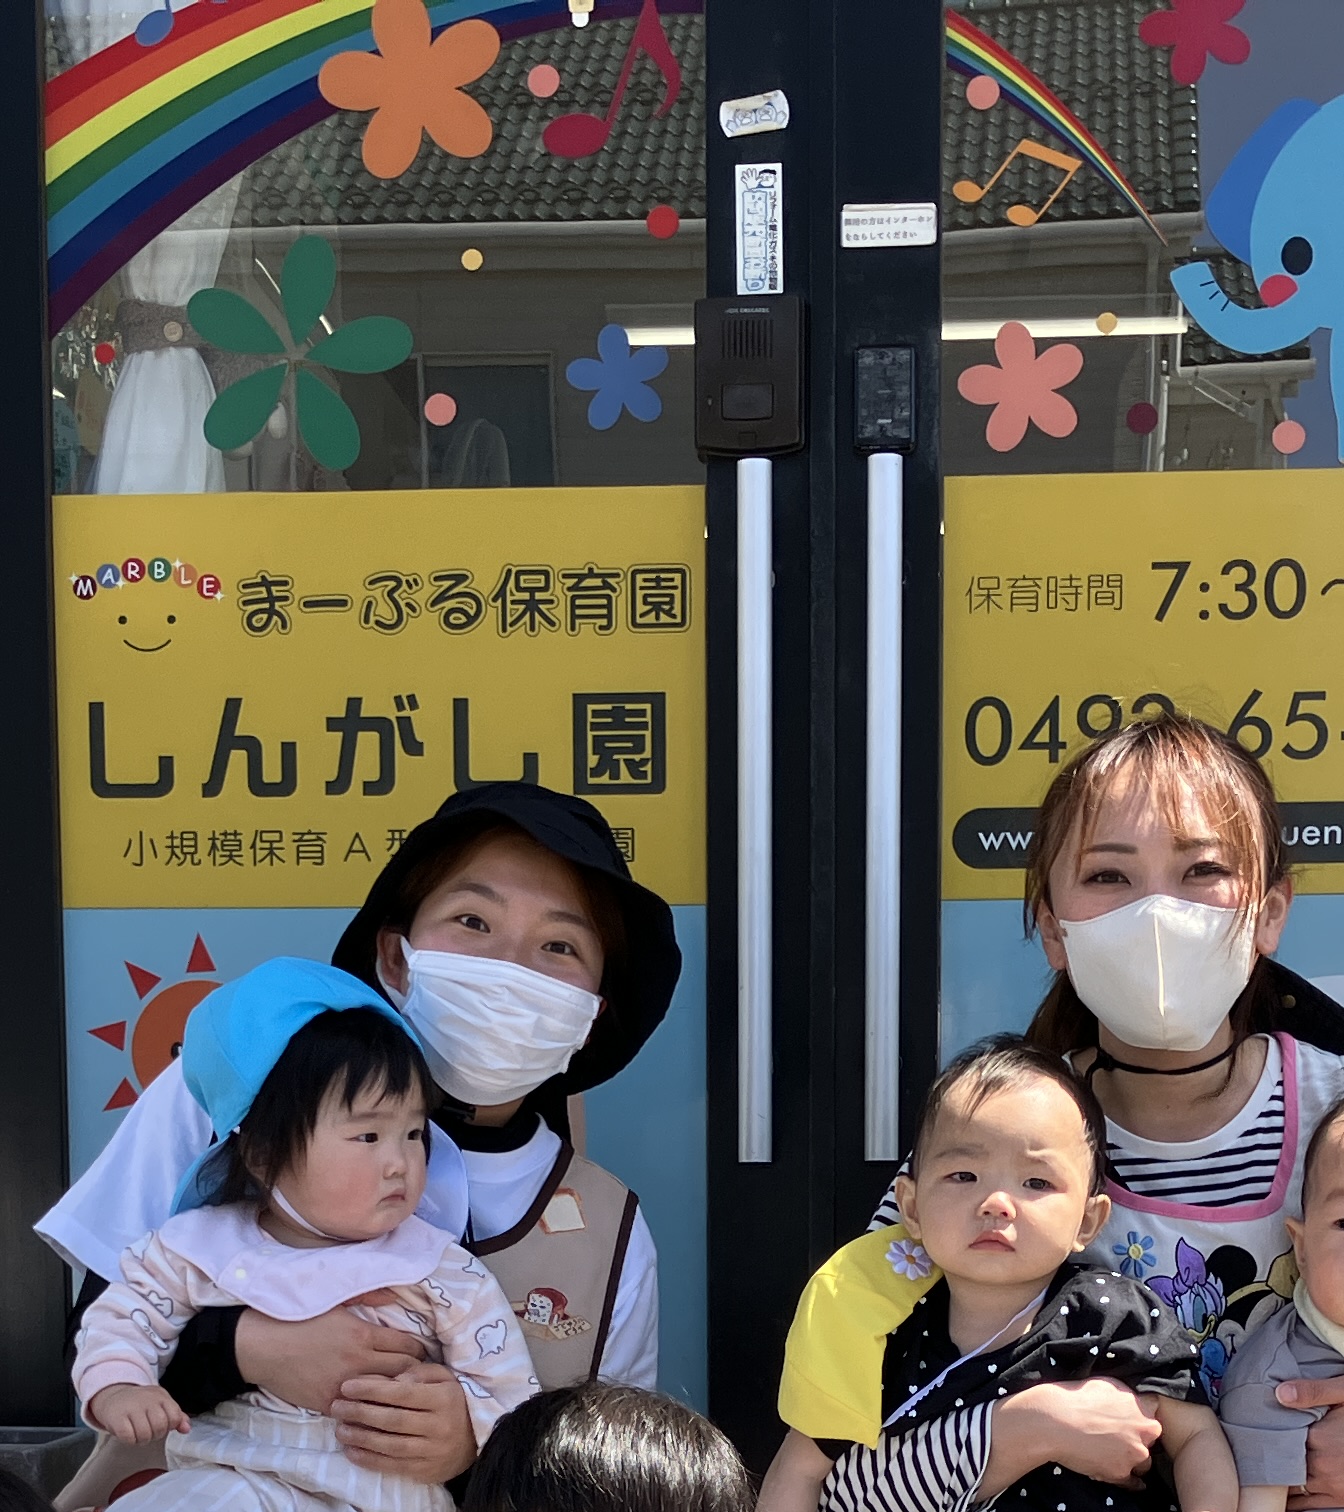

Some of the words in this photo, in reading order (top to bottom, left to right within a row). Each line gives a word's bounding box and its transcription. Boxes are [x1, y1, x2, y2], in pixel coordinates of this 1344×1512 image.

[74, 560, 217, 600] MARBLE
[237, 563, 690, 637] まーぶる保育園
[965, 574, 1124, 614] 保育時間
[88, 692, 667, 798] しんがし園
